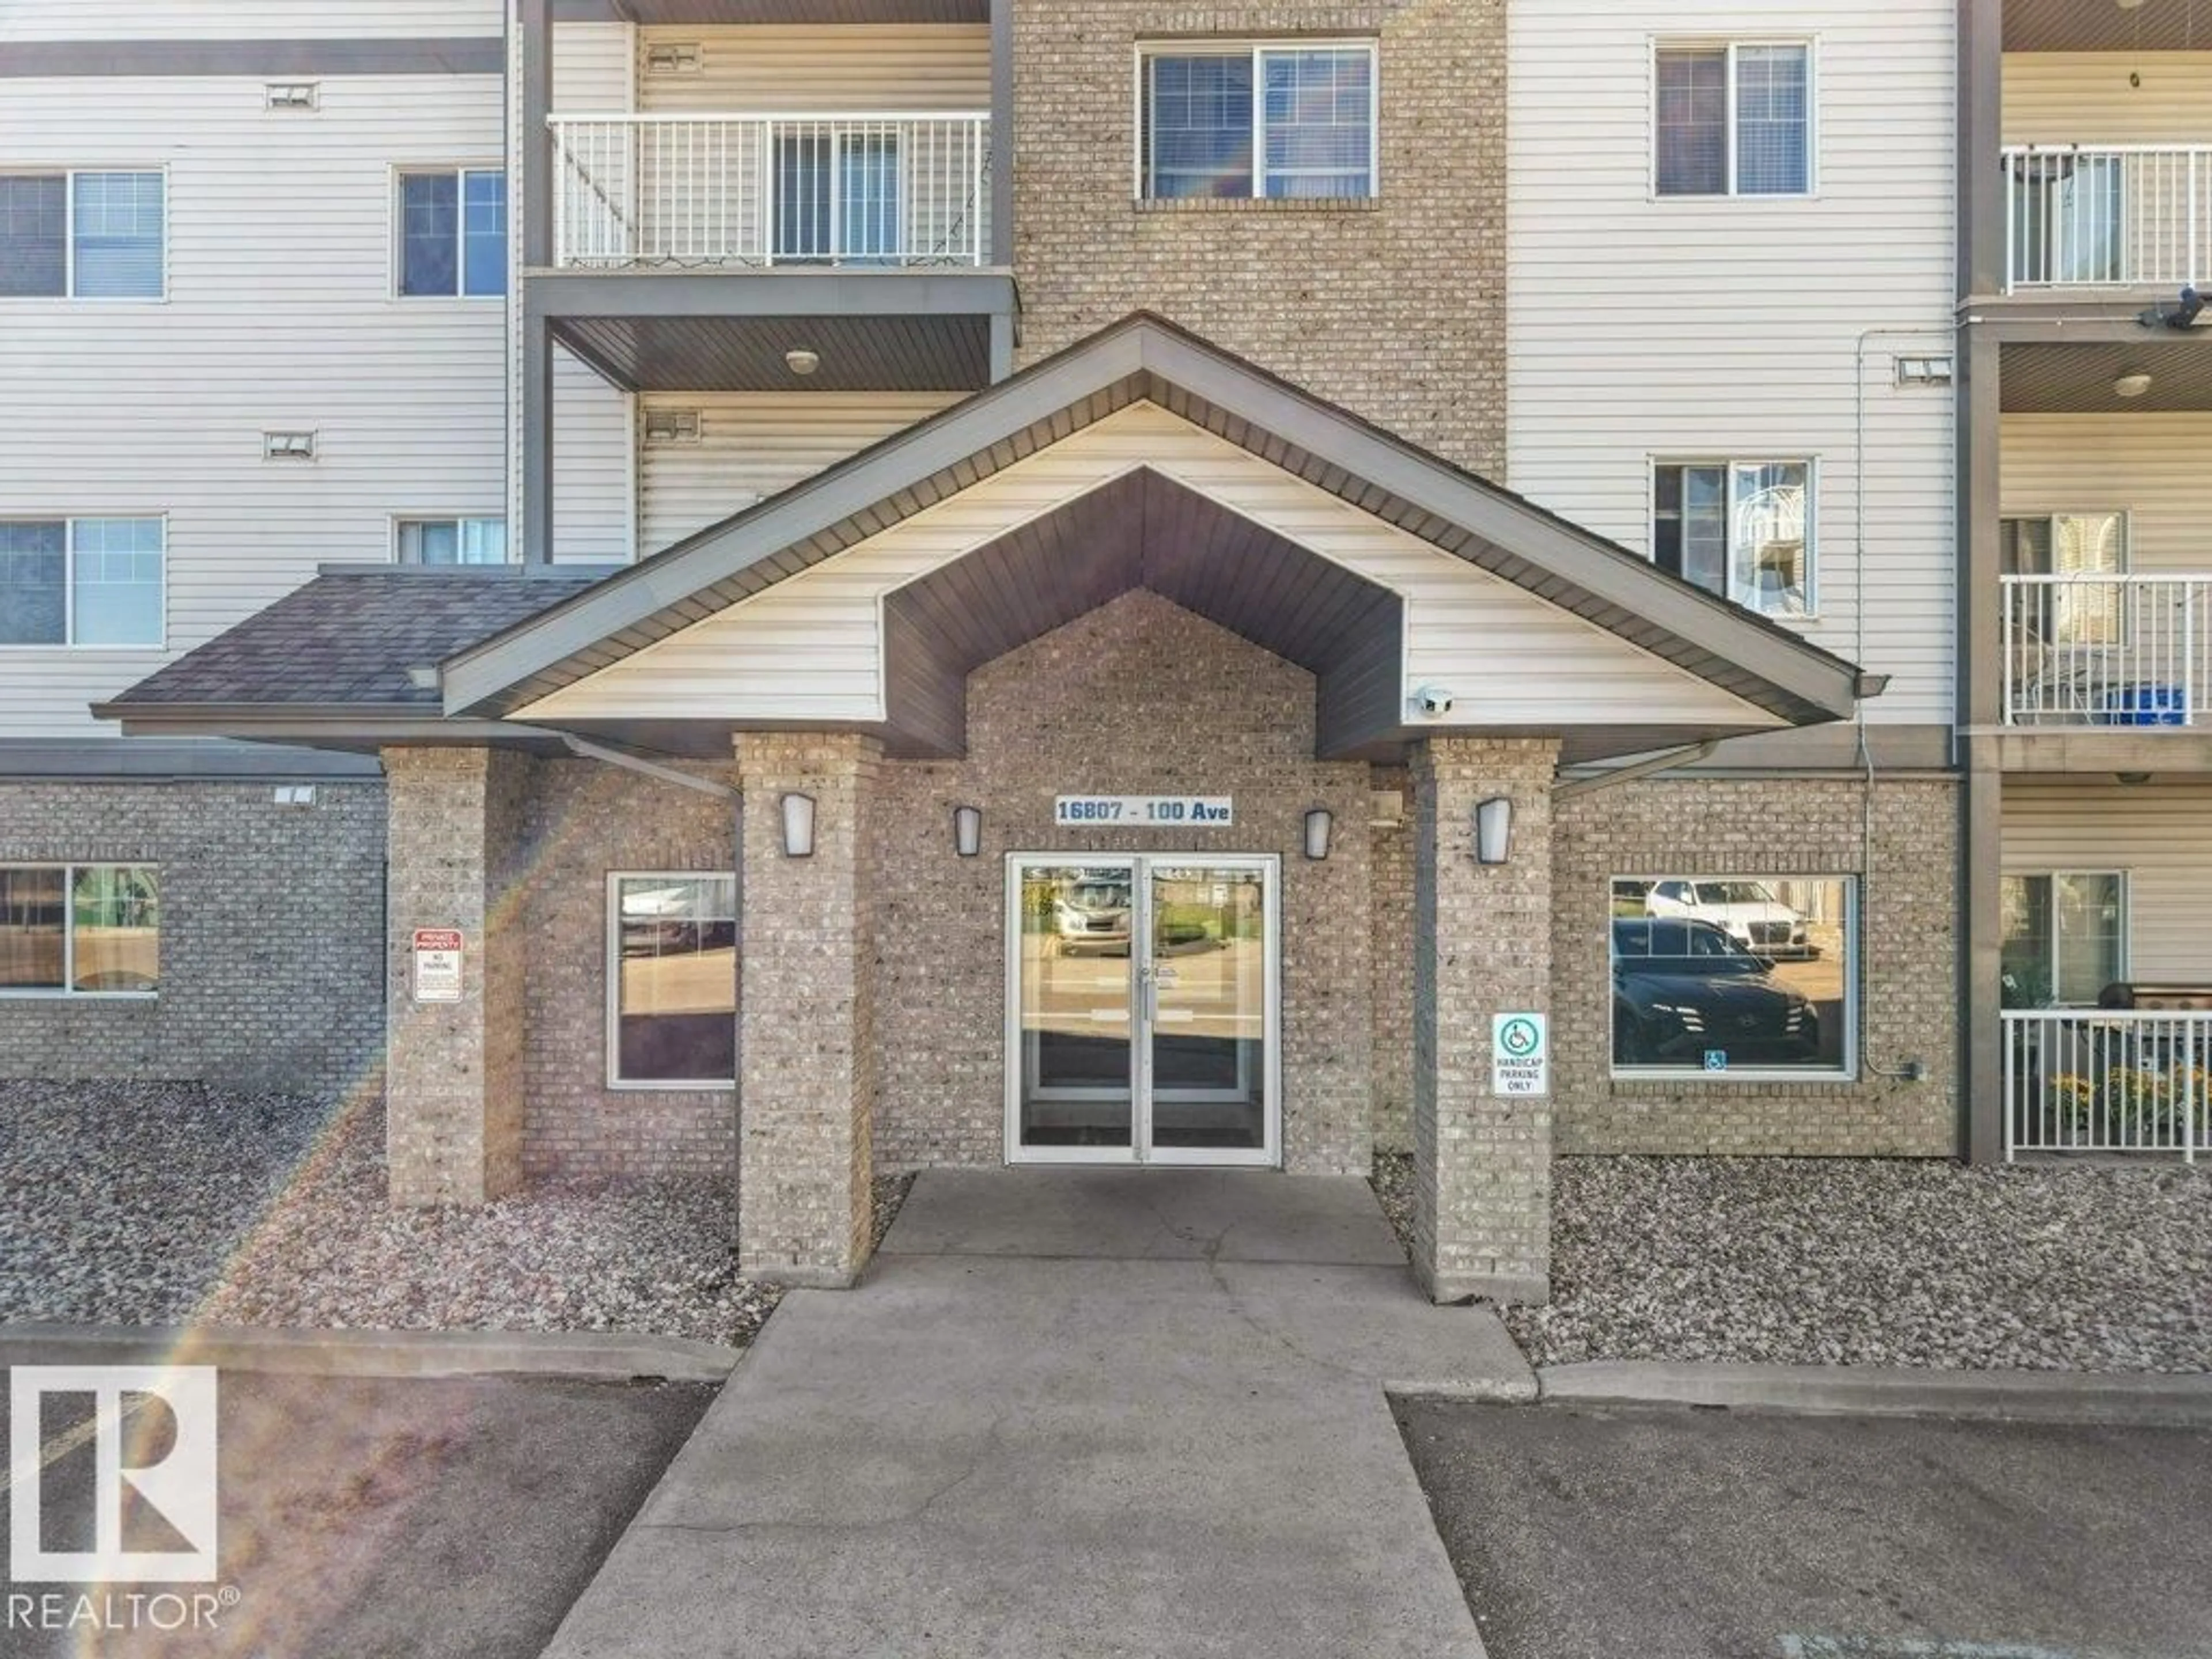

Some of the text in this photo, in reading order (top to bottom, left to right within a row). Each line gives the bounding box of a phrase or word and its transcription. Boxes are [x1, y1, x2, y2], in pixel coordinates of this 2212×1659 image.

[1058, 801, 1123, 820] 16807
[1146, 802, 1185, 820] 100
[1190, 802, 1229, 820] Ave
[421, 933, 455, 941] PRIVATE
[416, 941, 459, 949] PROPERTY
[1497, 1058, 1543, 1067] HANDICAP
[1500, 1070, 1539, 1079] PARKING
[1508, 1080, 1531, 1092] ONLY
